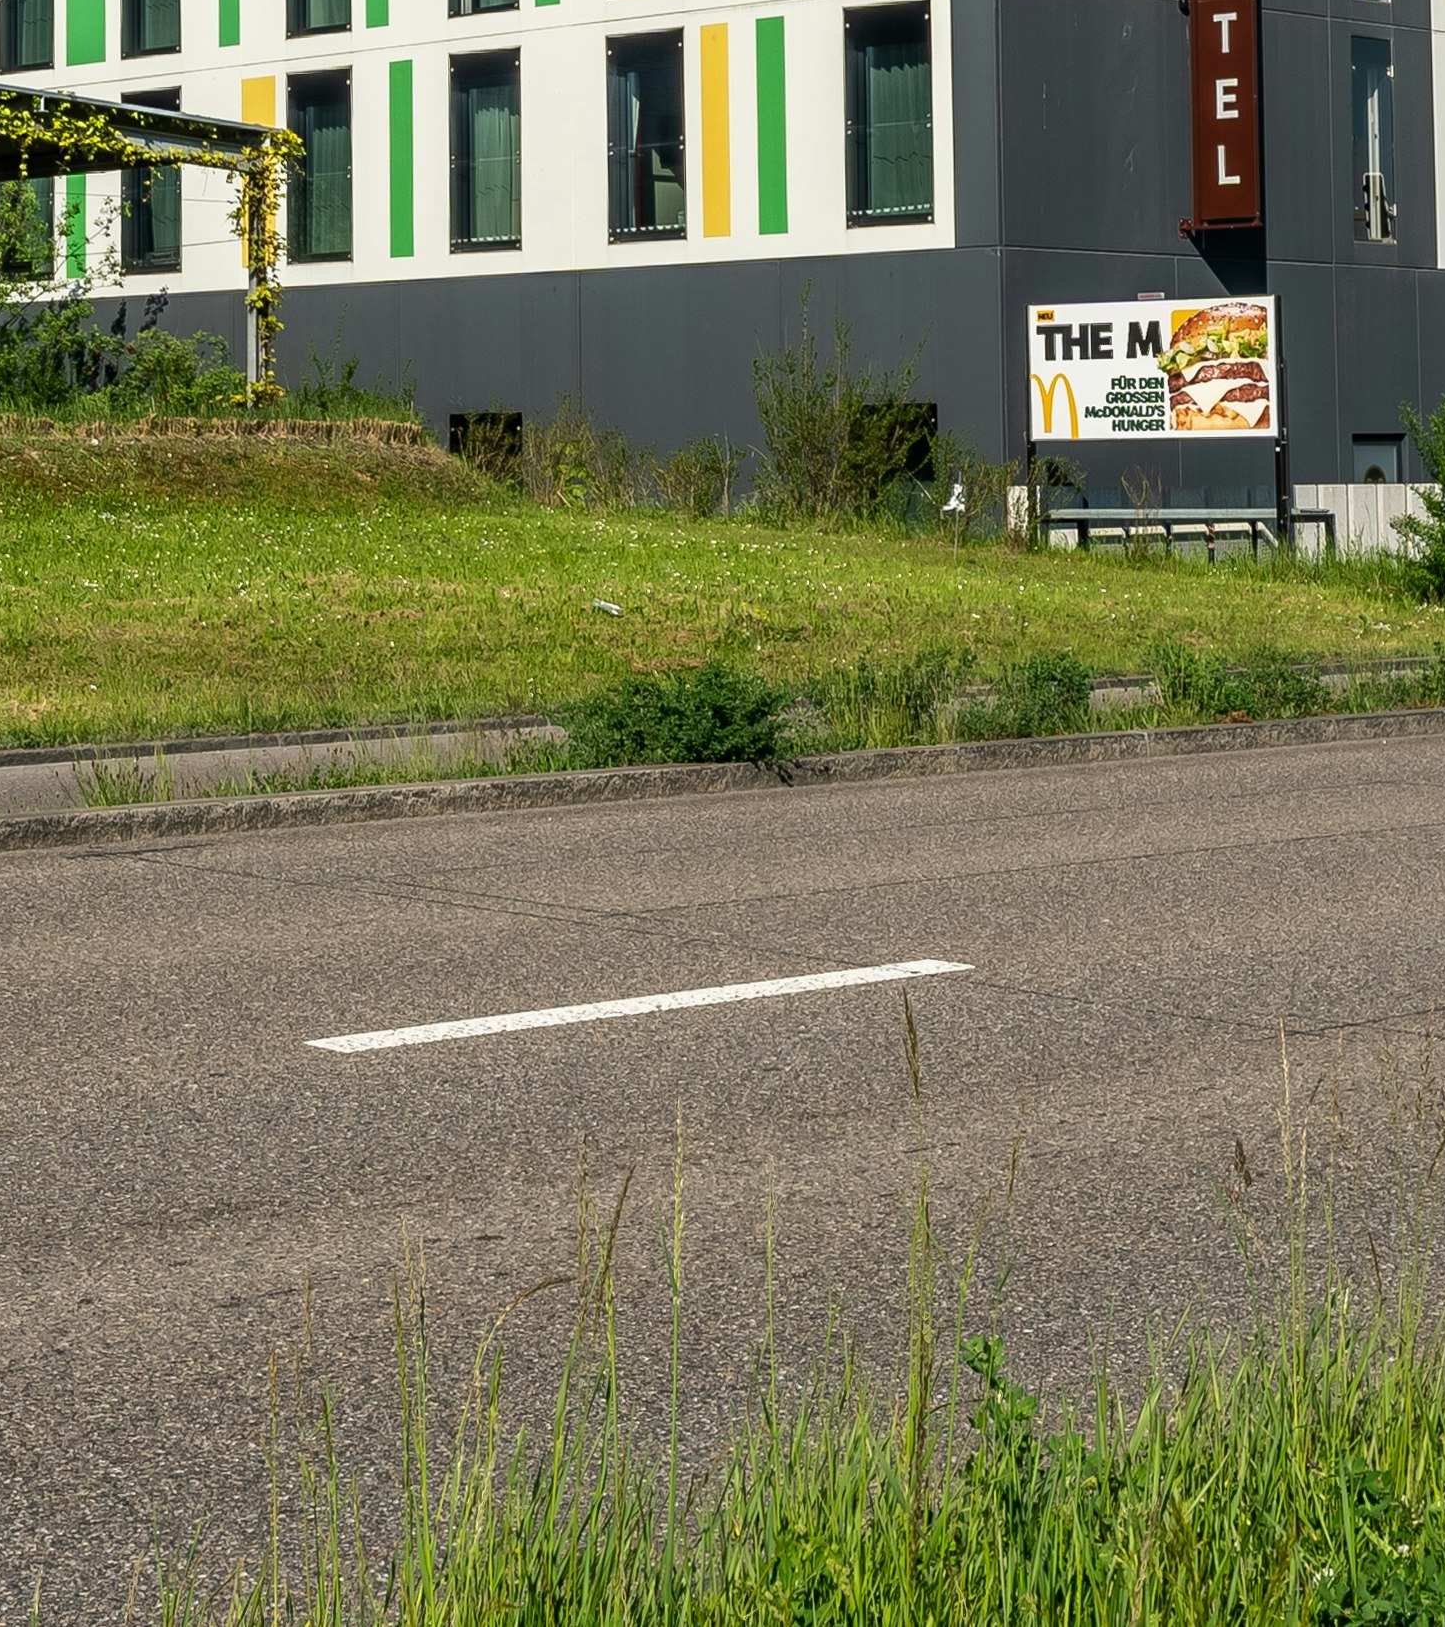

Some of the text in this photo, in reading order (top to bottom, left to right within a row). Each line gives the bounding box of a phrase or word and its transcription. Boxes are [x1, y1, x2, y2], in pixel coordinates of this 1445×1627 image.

[1036, 320, 1164, 361] THE M
[1111, 375, 1164, 390] FÜR DEN
[1105, 391, 1165, 404] GROSSEN
[1084, 405, 1165, 419] McDONALD'S
[1112, 419, 1165, 432] HUNGER
